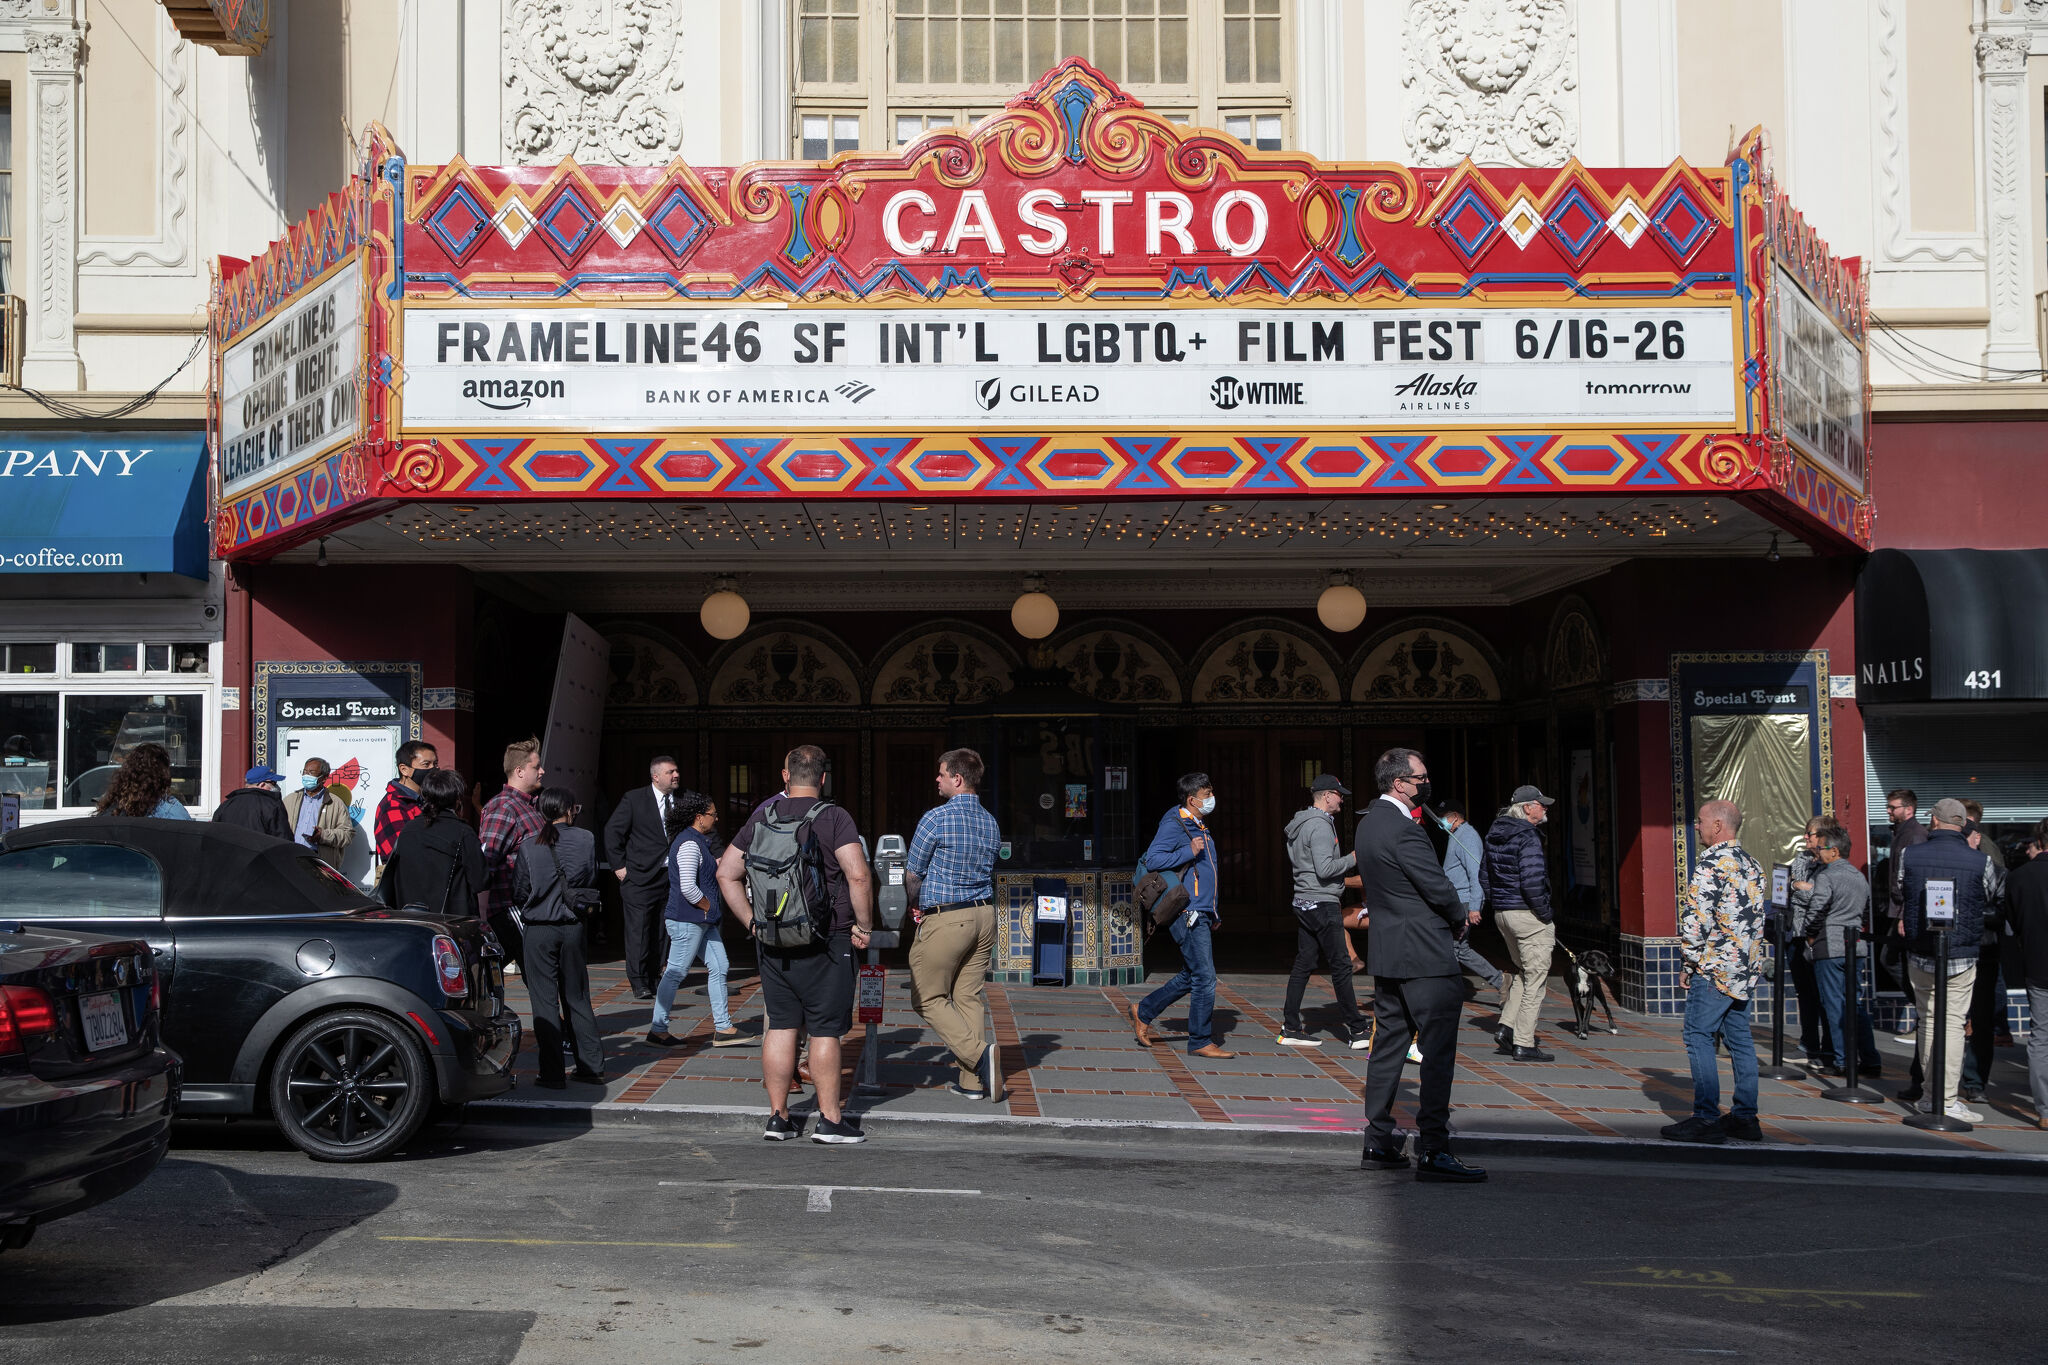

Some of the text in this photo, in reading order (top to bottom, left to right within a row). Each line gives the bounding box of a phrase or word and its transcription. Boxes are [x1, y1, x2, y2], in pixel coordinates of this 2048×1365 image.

[882, 189, 1269, 256] CASTRO
[252, 294, 336, 382] FRAMELINE46
[437, 319, 1685, 364] FRAMELINE46 SF INT'L LGBTQ+ FILM FEST 6/16-26
[243, 343, 340, 430] OPENING NIGHT:
[462, 379, 565, 400] amazon
[645, 389, 830, 404] BANK OF AMERICA
[1010, 385, 1100, 403] GILEAD
[1209, 376, 1304, 410] SHOWTIME
[1394, 372, 1477, 398] Alaska
[1585, 381, 1692, 394] tomorrow
[1400, 402, 1471, 410] AIRLINES
[223, 430, 265, 483] LEAGUE
[269, 419, 284, 460] OF
[287, 397, 325, 451] THEIR
[0, 449, 154, 477] PANY
[1862, 657, 1924, 685] NAILS
[1964, 670, 2001, 689] 431
[1694, 689, 1797, 706] Special Event
[281, 701, 397, 719] Special Event
[286, 739, 300, 757] F
